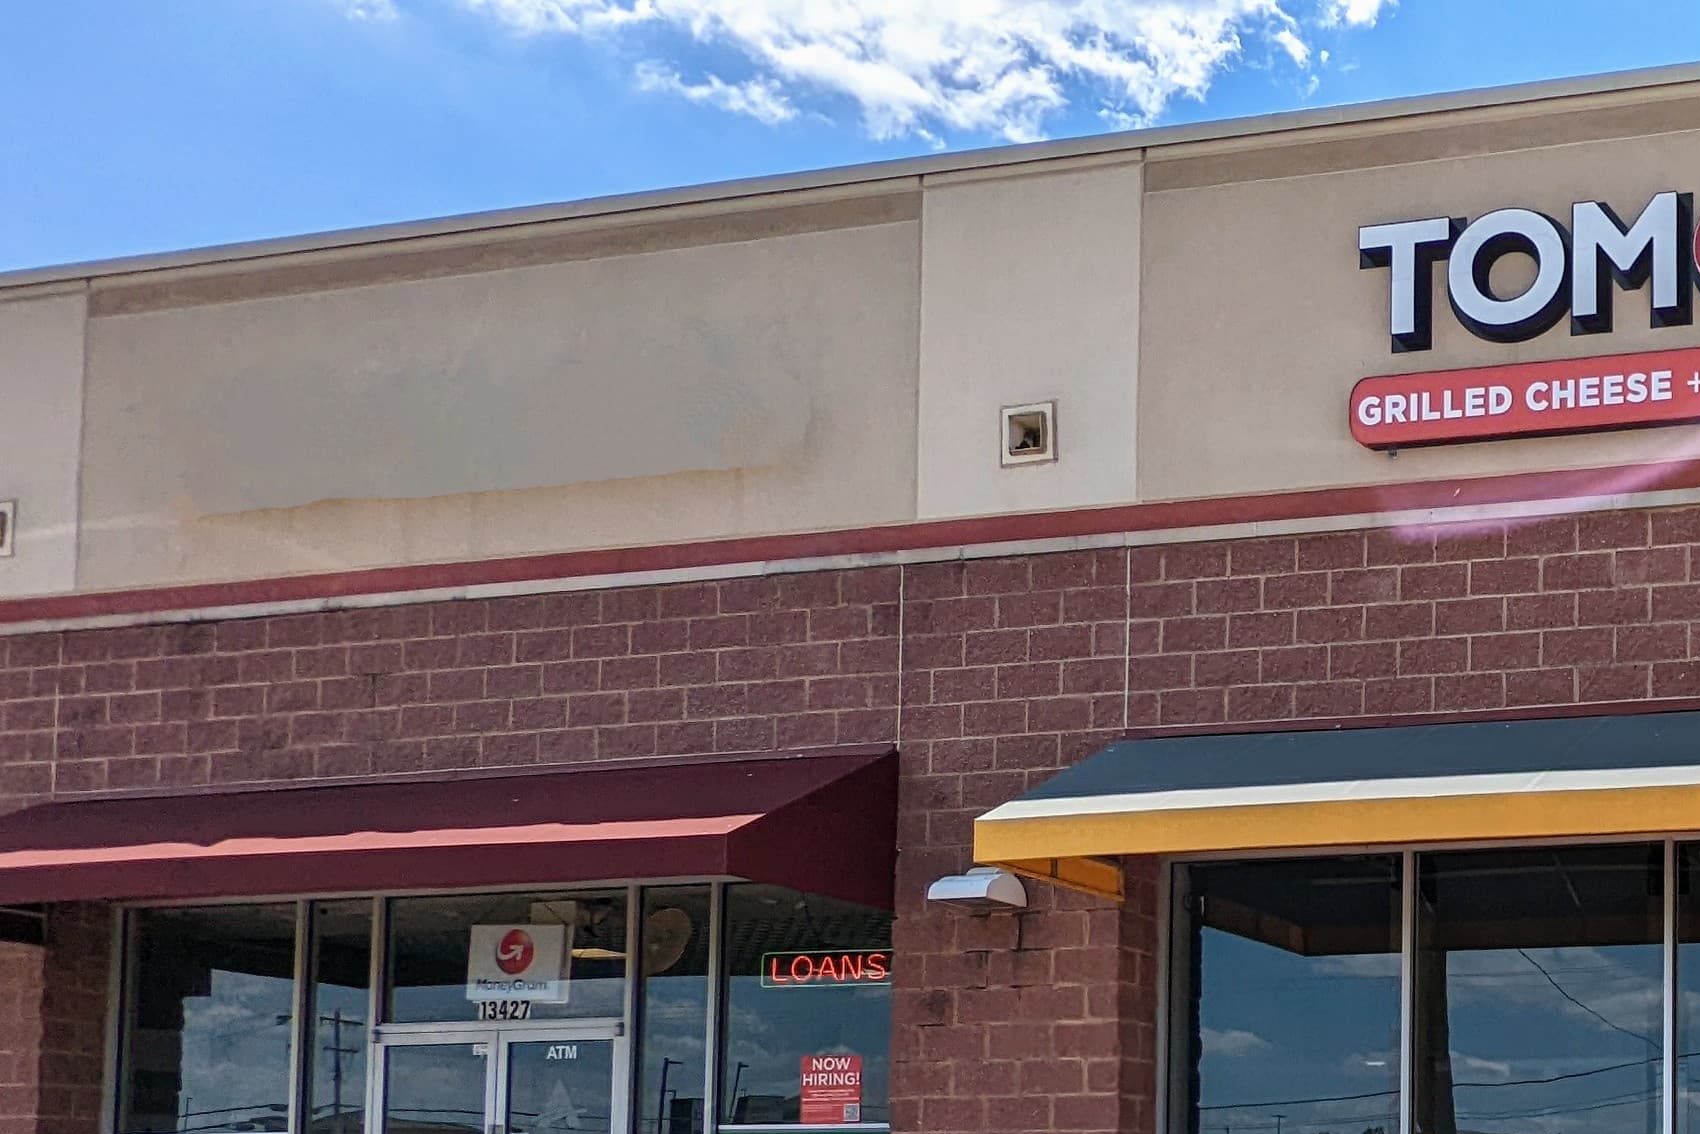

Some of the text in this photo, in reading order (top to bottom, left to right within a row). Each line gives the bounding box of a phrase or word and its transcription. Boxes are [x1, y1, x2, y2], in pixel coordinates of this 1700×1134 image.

[1357, 387, 1512, 427] GRILLED
[1525, 370, 1673, 411] CHEESE
[772, 953, 886, 983] LOANS
[481, 1000, 531, 1020] 13427
[546, 1045, 577, 1060] ATM
[812, 1057, 851, 1071] NOW
[803, 1072, 861, 1086] HIRING!
